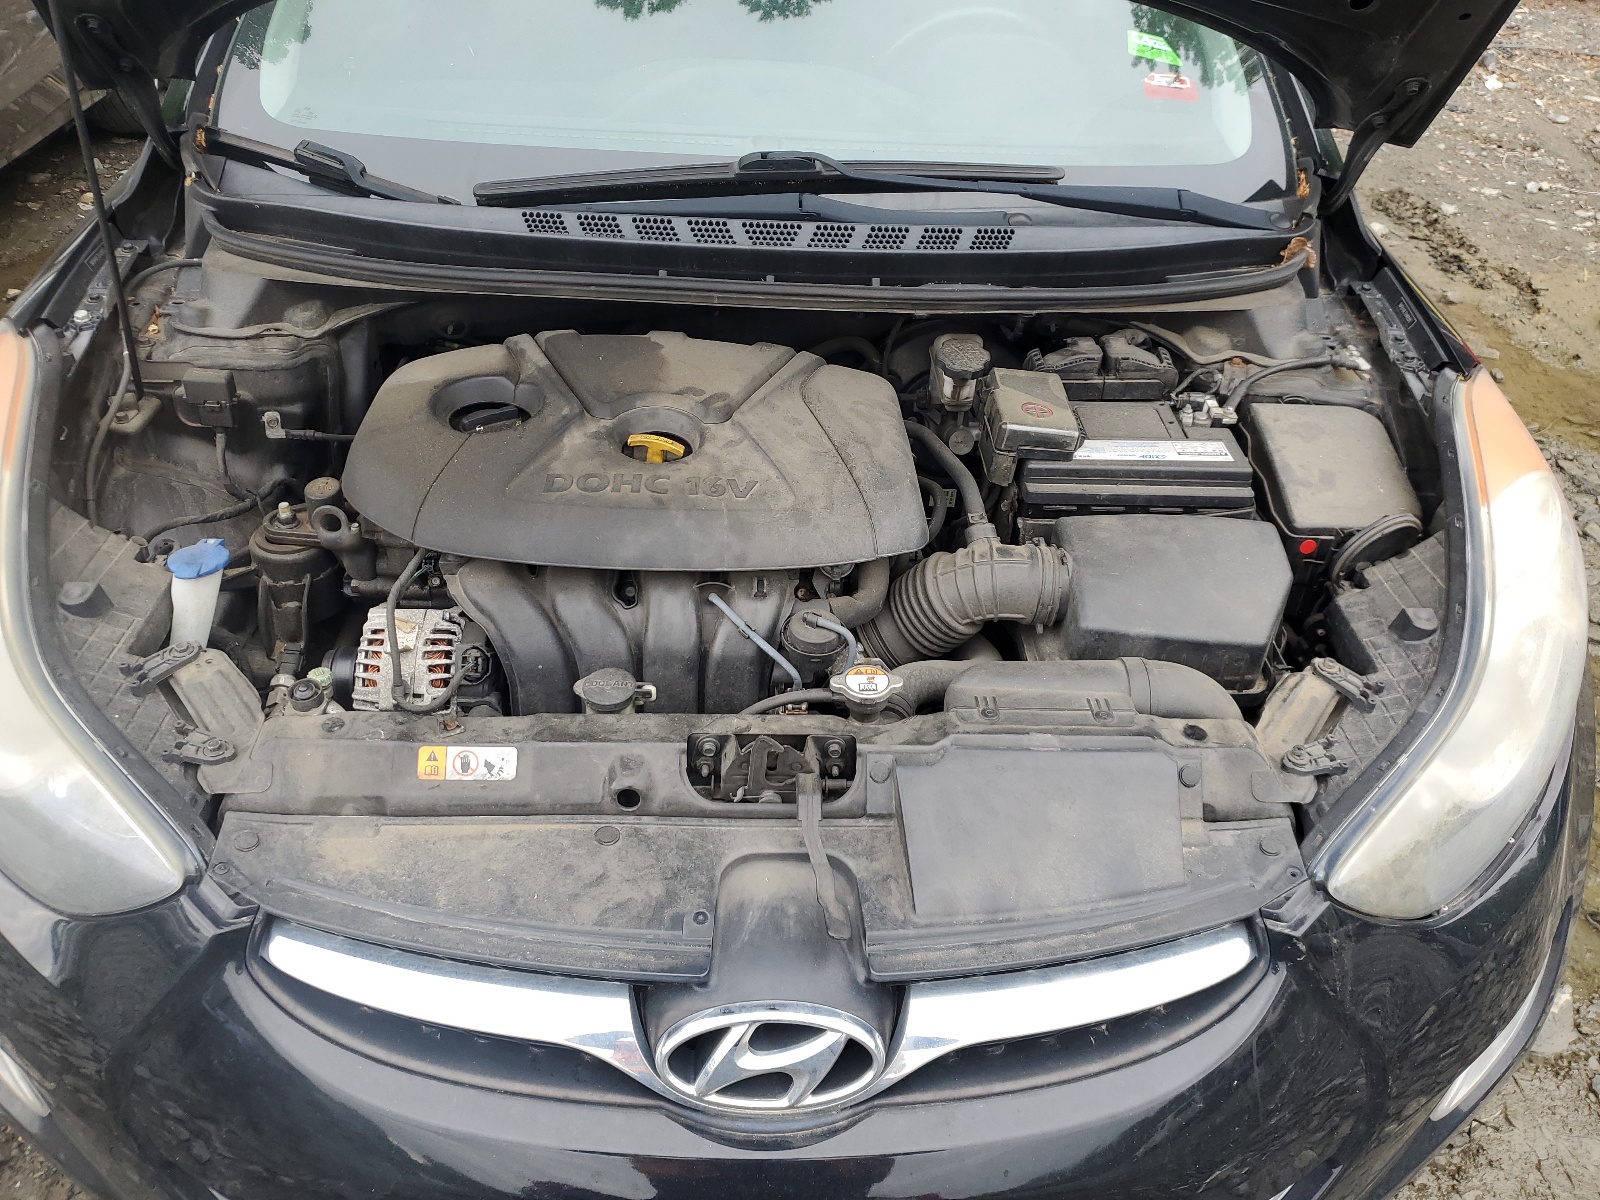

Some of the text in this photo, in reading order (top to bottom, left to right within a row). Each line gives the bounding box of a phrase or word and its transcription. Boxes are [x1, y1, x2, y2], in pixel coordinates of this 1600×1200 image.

[543, 473, 758, 498] DOHC 16V
[584, 679, 634, 688] COOLANT
